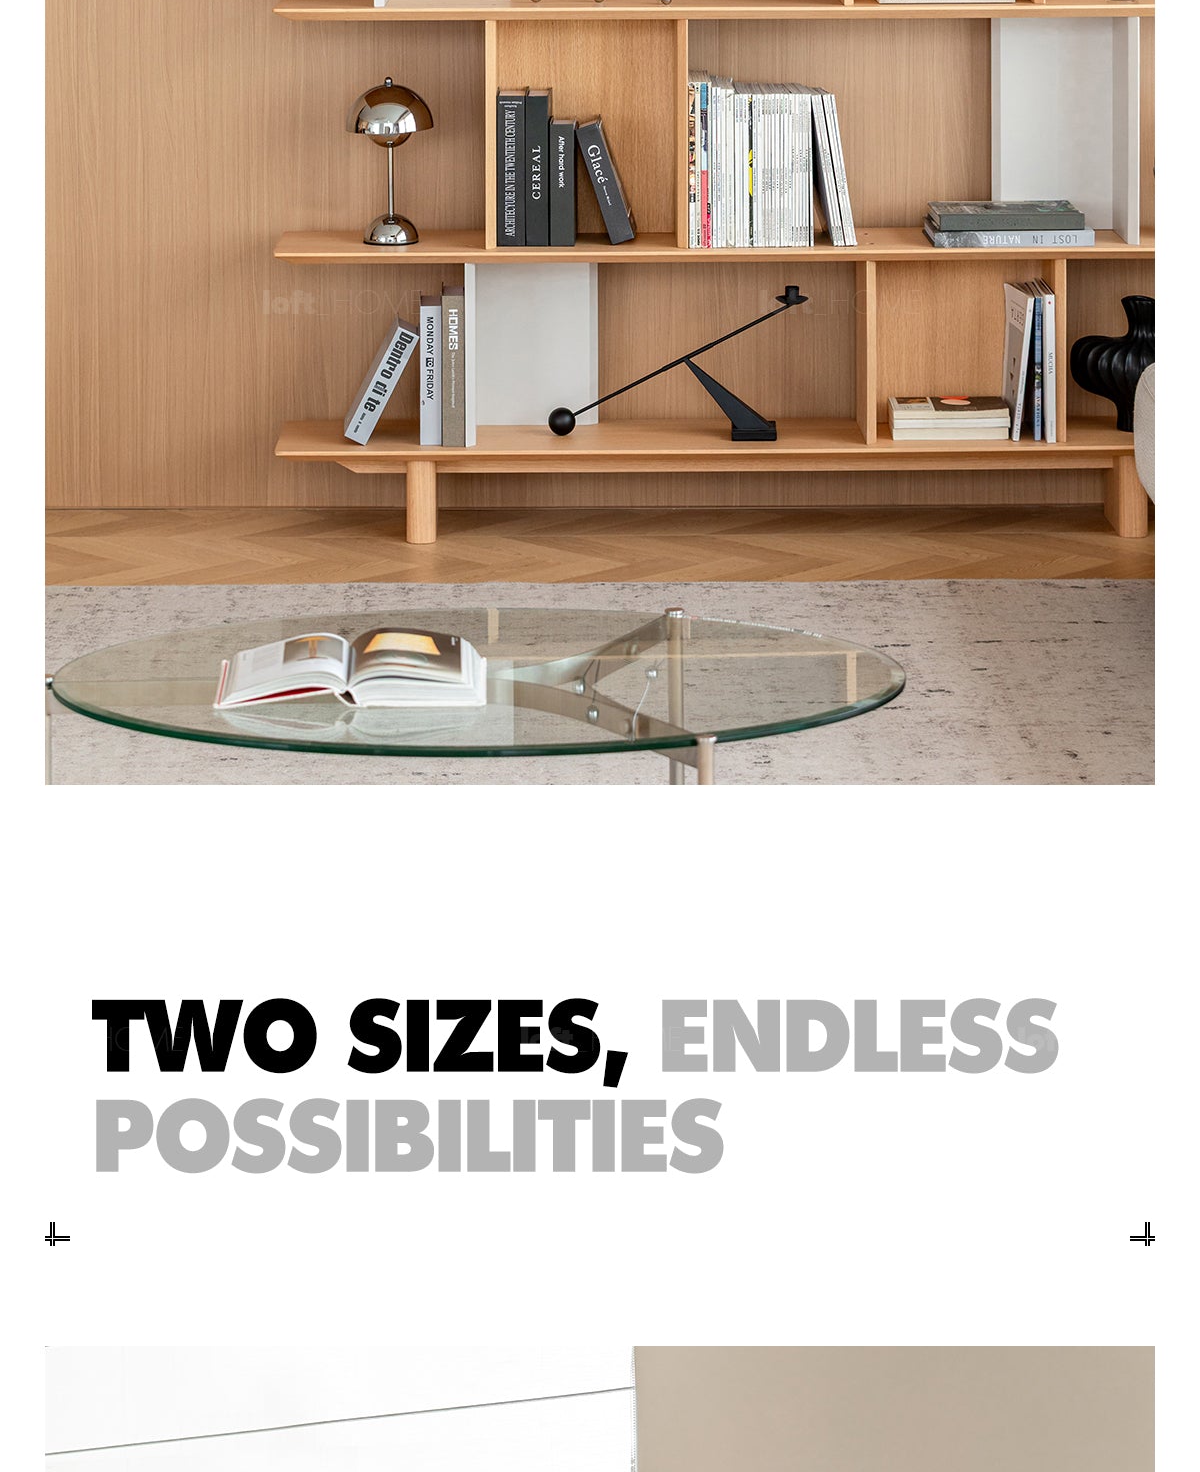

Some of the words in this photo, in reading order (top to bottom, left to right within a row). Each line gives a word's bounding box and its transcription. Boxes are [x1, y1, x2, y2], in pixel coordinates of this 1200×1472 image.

[504, 109, 516, 138] CENTURY
[504, 171, 516, 183] THE
[532, 145, 541, 200] CEREAL
[587, 144, 608, 184] Glacé
[983, 235, 1021, 245] NATURE
[1032, 235, 1044, 245] IN
[1052, 234, 1078, 245] LOST
[426, 316, 435, 355] MONDAY
[448, 308, 458, 351] HOMES
[380, 331, 414, 379] Dentro
[372, 380, 388, 397] di
[426, 368, 435, 400] FRIDAY
[363, 397, 380, 413] te
